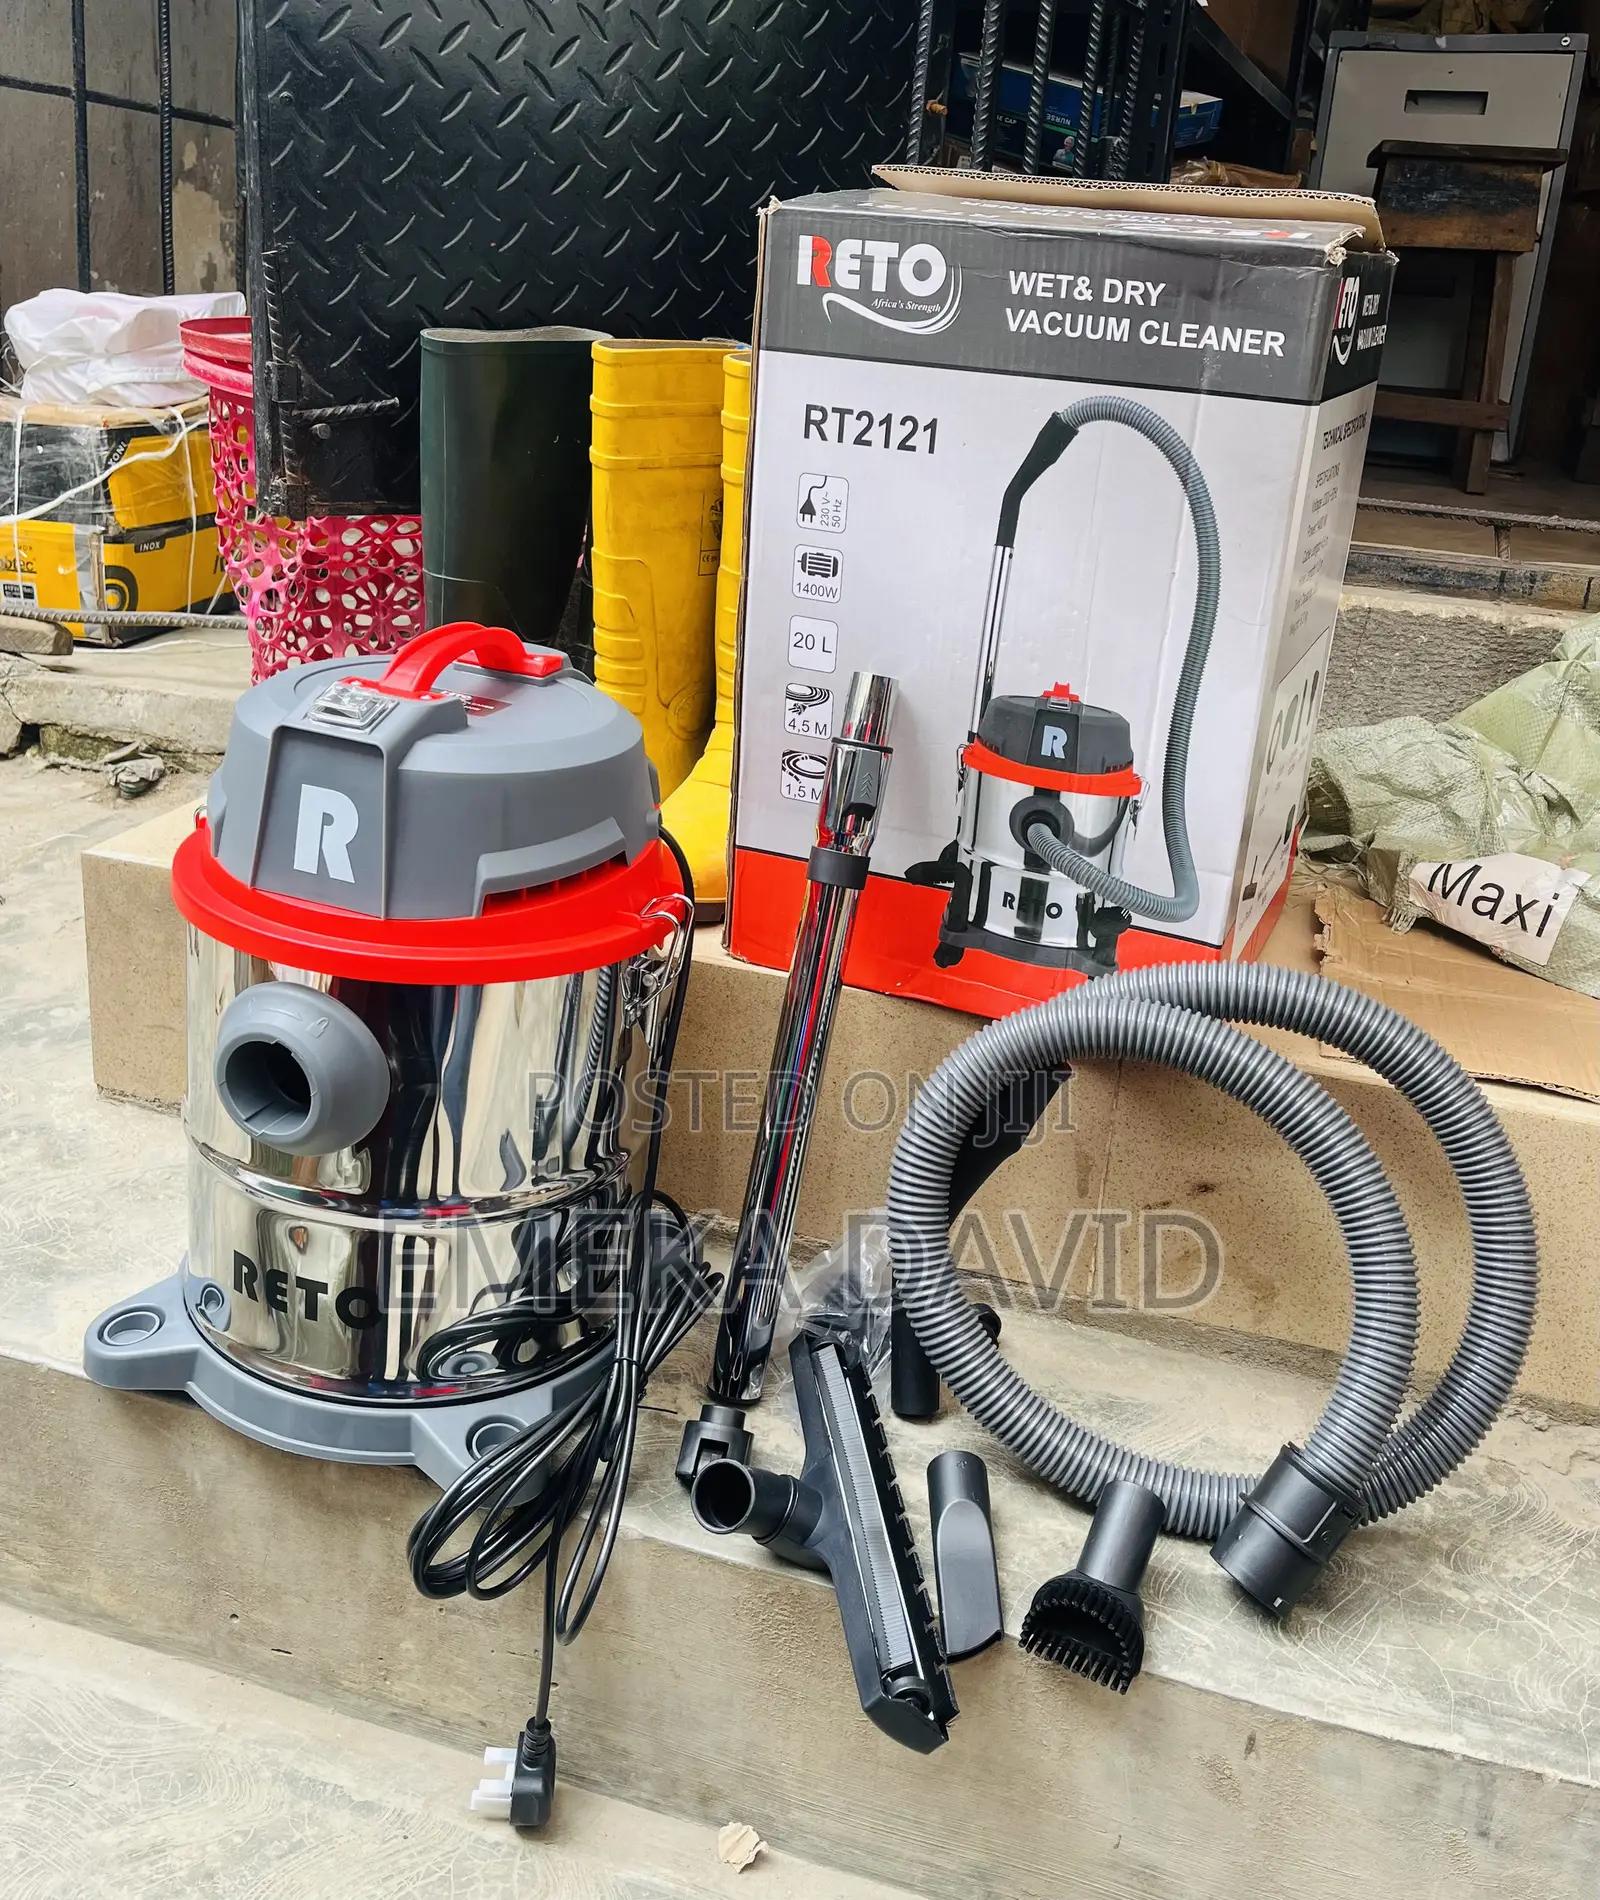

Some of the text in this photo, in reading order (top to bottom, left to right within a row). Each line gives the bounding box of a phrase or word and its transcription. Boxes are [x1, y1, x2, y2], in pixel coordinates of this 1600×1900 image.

[1046, 113, 1071, 126] NURSE
[796, 234, 947, 297] RETO
[1009, 269, 1167, 308] WET& DRY
[871, 298, 941, 314] Africa's Strength
[1005, 307, 1286, 358] VACUUM CLEANER
[804, 403, 939, 456] RT2121
[820, 507, 830, 527] 230
[831, 498, 843, 528] 50 Hz
[139, 541, 161, 551] INOX
[796, 582, 839, 599] 1400W
[793, 632, 832, 654] 20 L
[788, 718, 828, 736] 4,5 M
[1040, 725, 1068, 760] R
[786, 783, 806, 799] 1,5
[293, 783, 359, 884] R
[1427, 862, 1560, 939] Maxi
[233, 1249, 385, 1331] RETO
